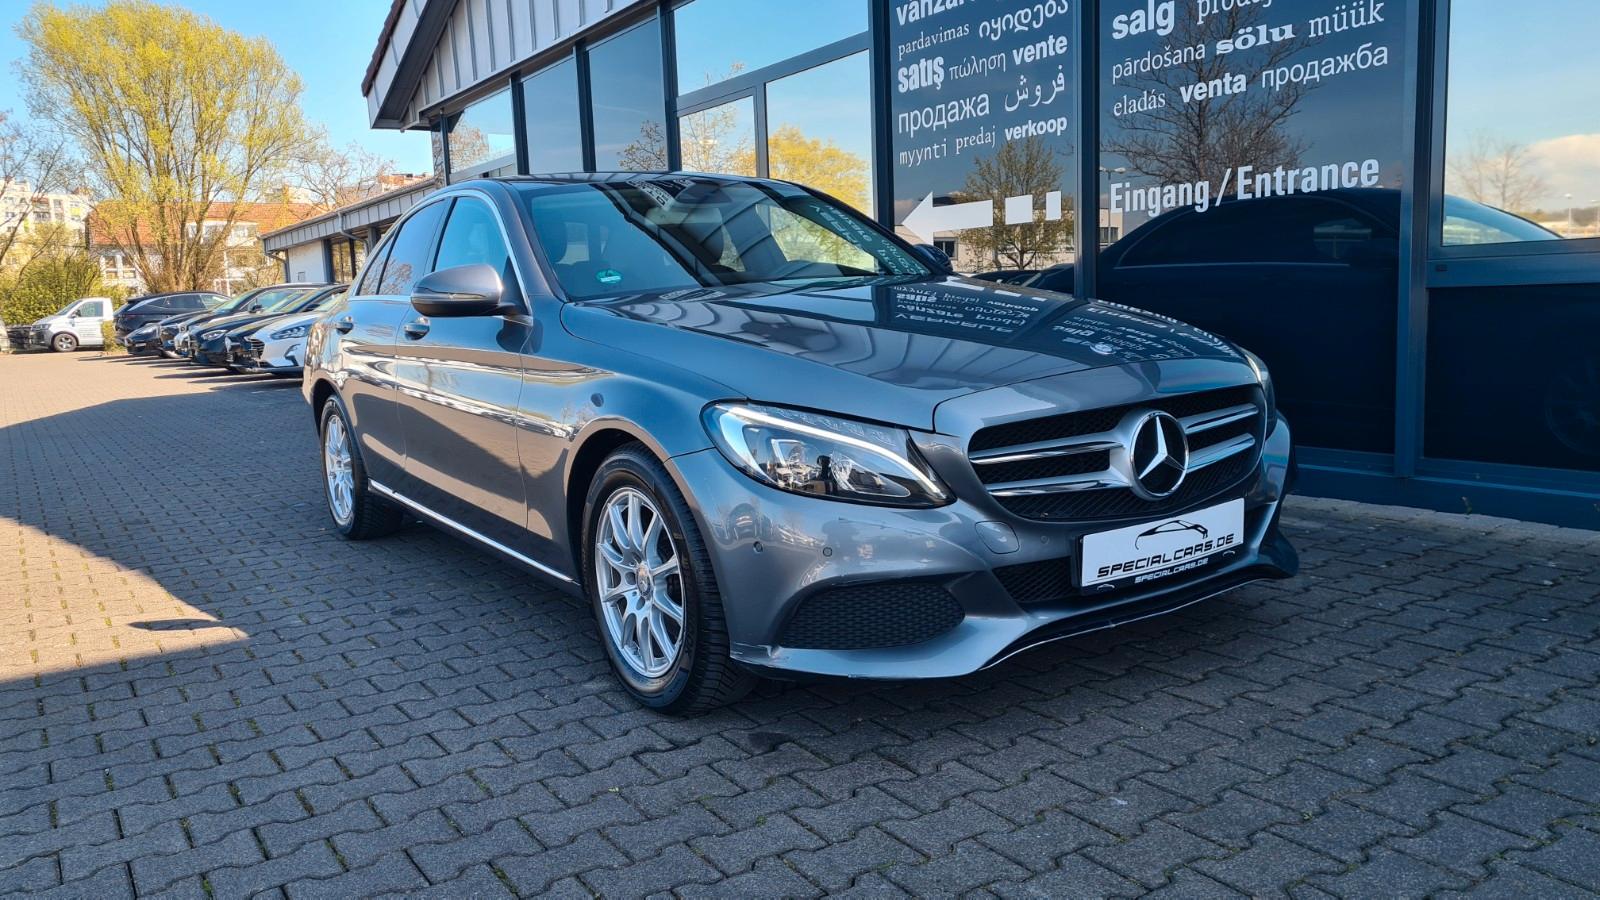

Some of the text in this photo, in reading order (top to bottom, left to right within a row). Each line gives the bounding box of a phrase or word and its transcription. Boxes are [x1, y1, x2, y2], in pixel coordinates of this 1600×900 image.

[898, 23, 971, 61] pardavimas
[1112, 0, 1174, 39] salg
[1112, 0, 1385, 84] pārdošana sölu müük
[898, 35, 1068, 93] satış πώληση vente
[1113, 42, 1388, 117] eladás venta продажба
[898, 64, 1065, 138] продажа فروش
[899, 116, 1068, 168] myynti predaj verkoop
[1109, 181, 1209, 217] Eingang
[1237, 158, 1379, 200] Entrance
[1097, 533, 1235, 578] SPECIALCARS.DE
